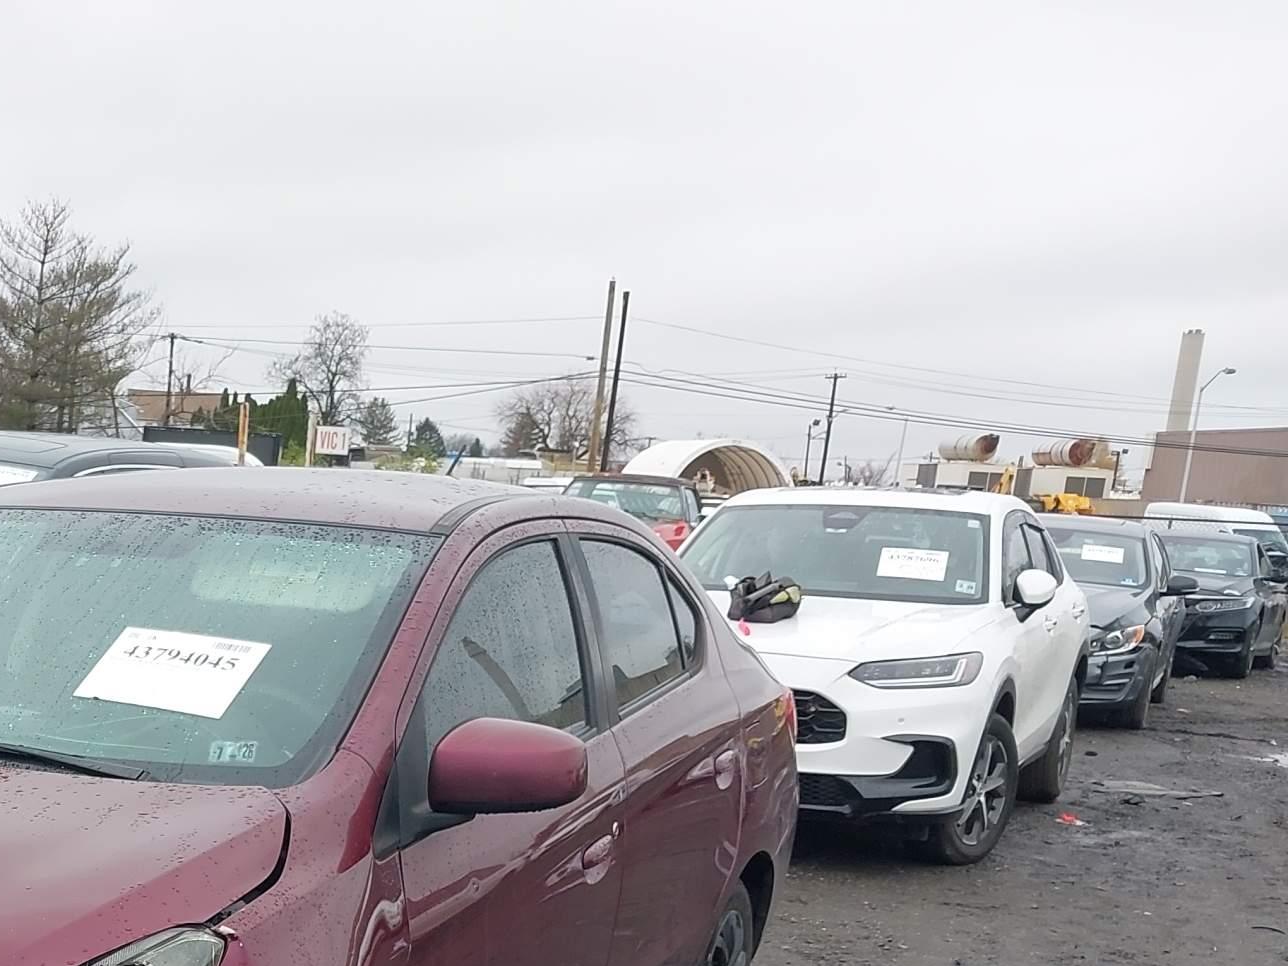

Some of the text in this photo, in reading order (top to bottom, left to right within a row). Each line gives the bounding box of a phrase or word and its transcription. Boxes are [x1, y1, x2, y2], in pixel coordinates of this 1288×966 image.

[320, 431, 347, 450] VIC 1
[123, 645, 241, 671] 43794045
